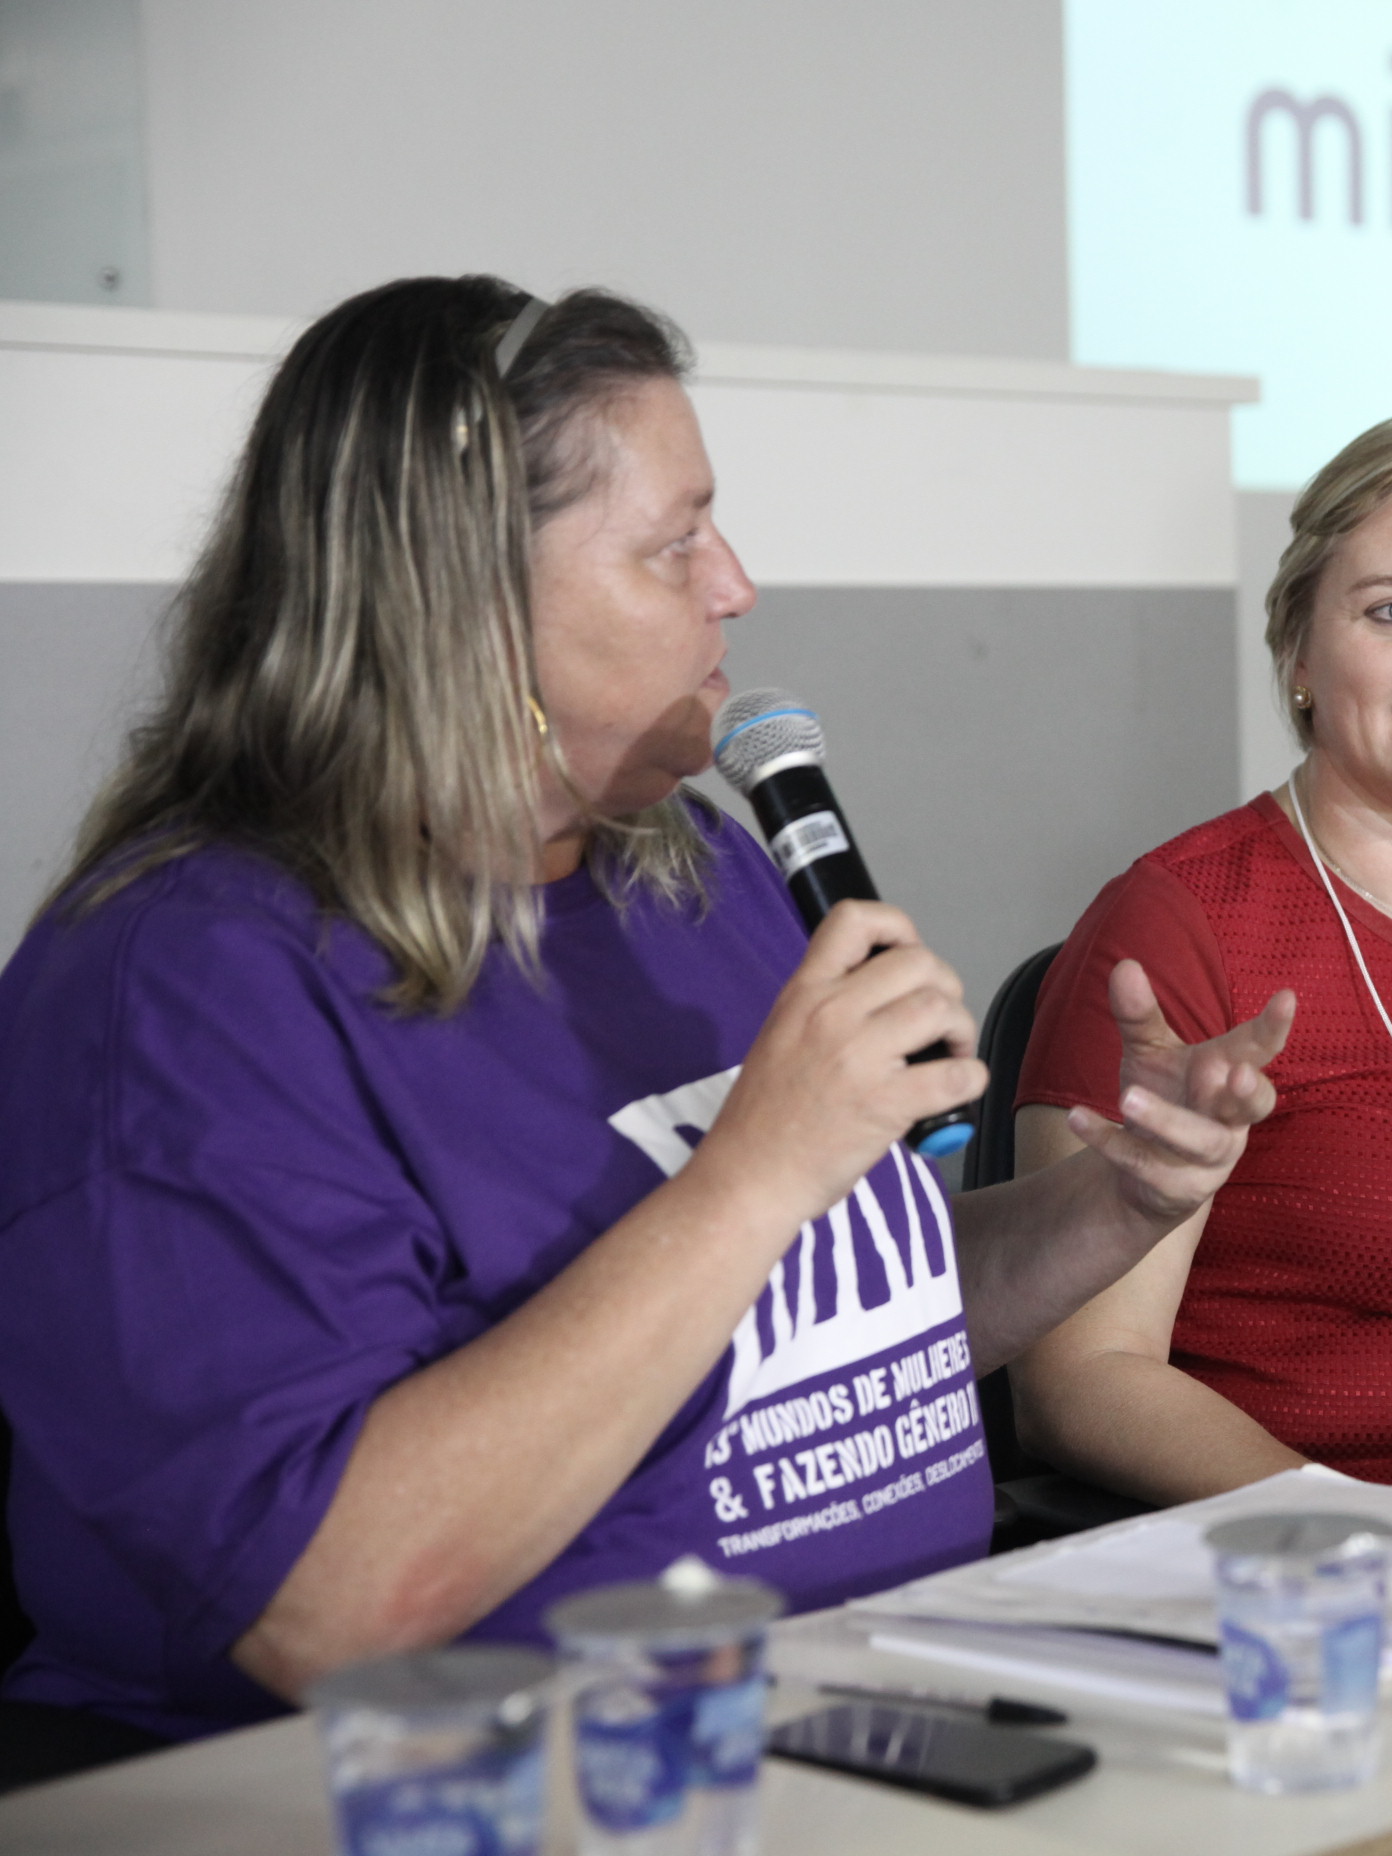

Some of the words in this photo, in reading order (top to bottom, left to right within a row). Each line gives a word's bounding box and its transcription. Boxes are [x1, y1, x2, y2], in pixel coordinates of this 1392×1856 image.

[709, 1476, 749, 1523] &
[753, 1424, 895, 1511] FAZENDO
[894, 1387, 970, 1459] GÊNERO
[740, 1383, 853, 1456] MUNDOS
[852, 1366, 892, 1416] DE
[891, 1329, 971, 1402] MULHERES
